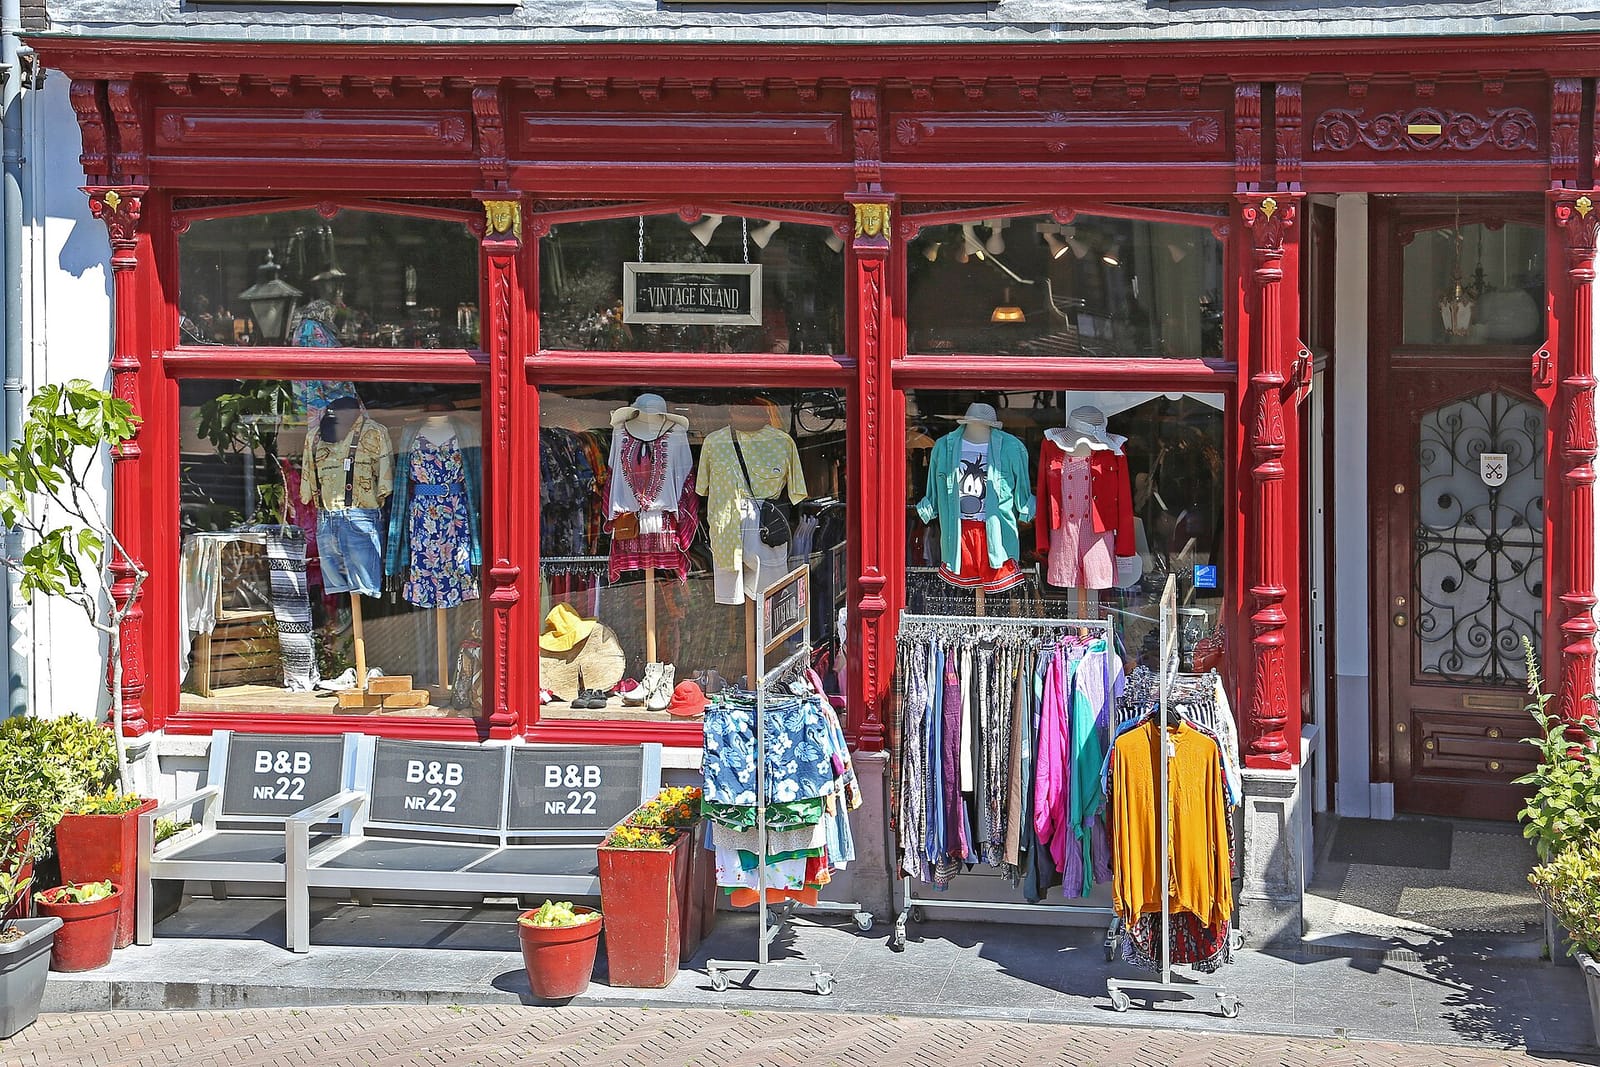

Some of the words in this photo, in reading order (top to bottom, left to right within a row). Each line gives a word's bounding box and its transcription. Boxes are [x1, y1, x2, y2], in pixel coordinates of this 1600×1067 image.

[648, 286, 696, 308] VINTAGE
[699, 287, 739, 309] ISLAND
[254, 750, 311, 774] B&B
[406, 760, 463, 786] B&B
[544, 764, 602, 788] B&B
